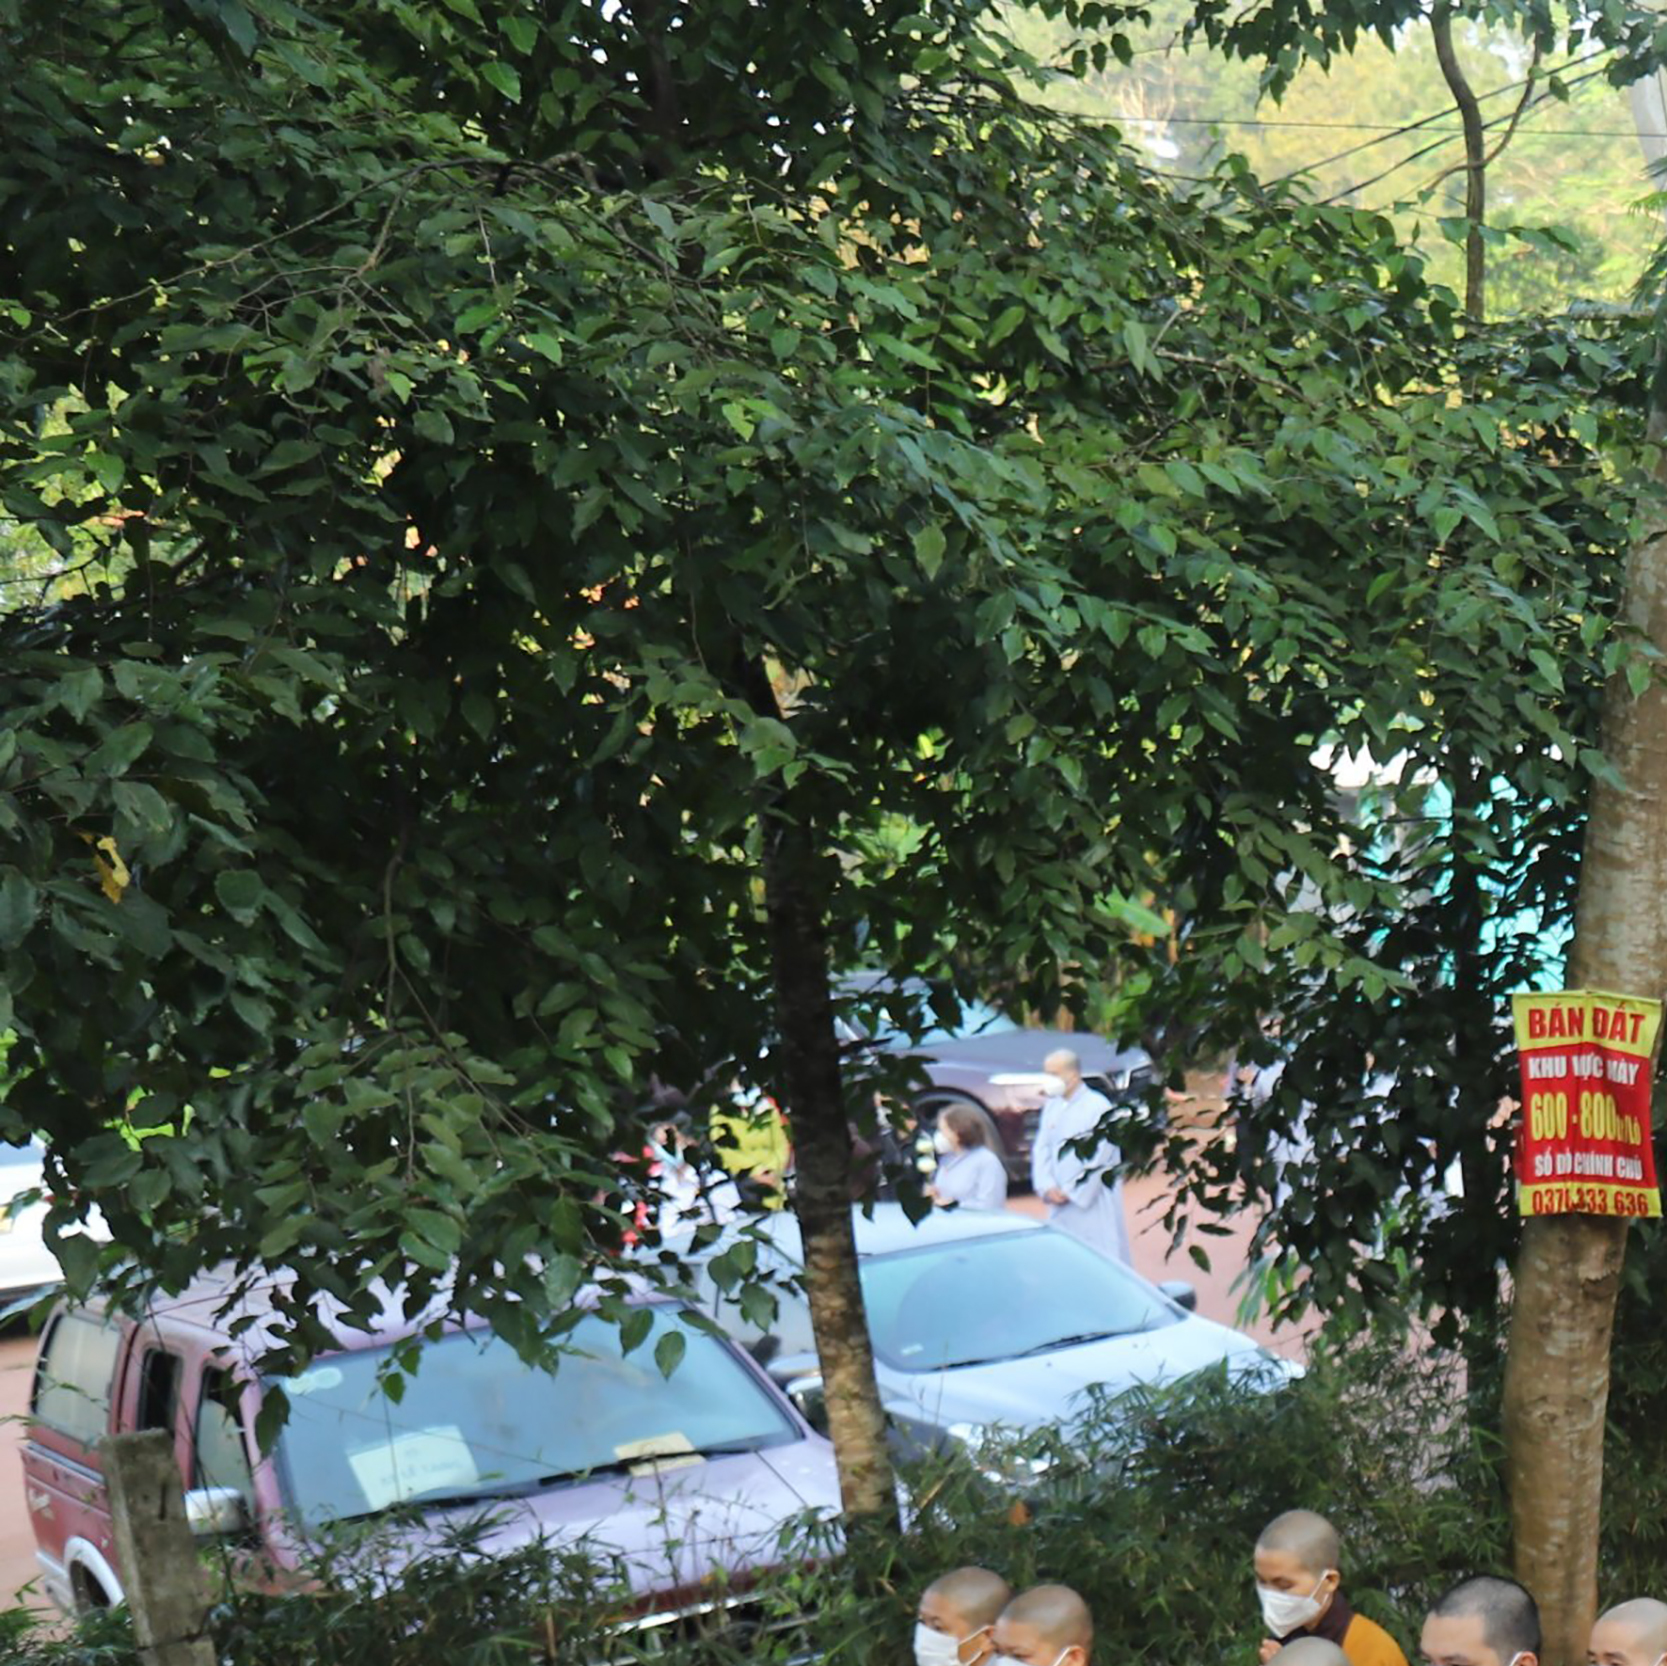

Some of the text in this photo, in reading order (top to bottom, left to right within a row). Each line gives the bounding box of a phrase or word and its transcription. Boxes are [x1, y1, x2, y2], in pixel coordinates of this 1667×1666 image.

[1528, 1002, 1645, 1043] BÁN ĐẤT
[1529, 1056, 1566, 1079] KHU
[1531, 1093, 1567, 1140] 600
[1615, 1191, 1648, 1216] 636
